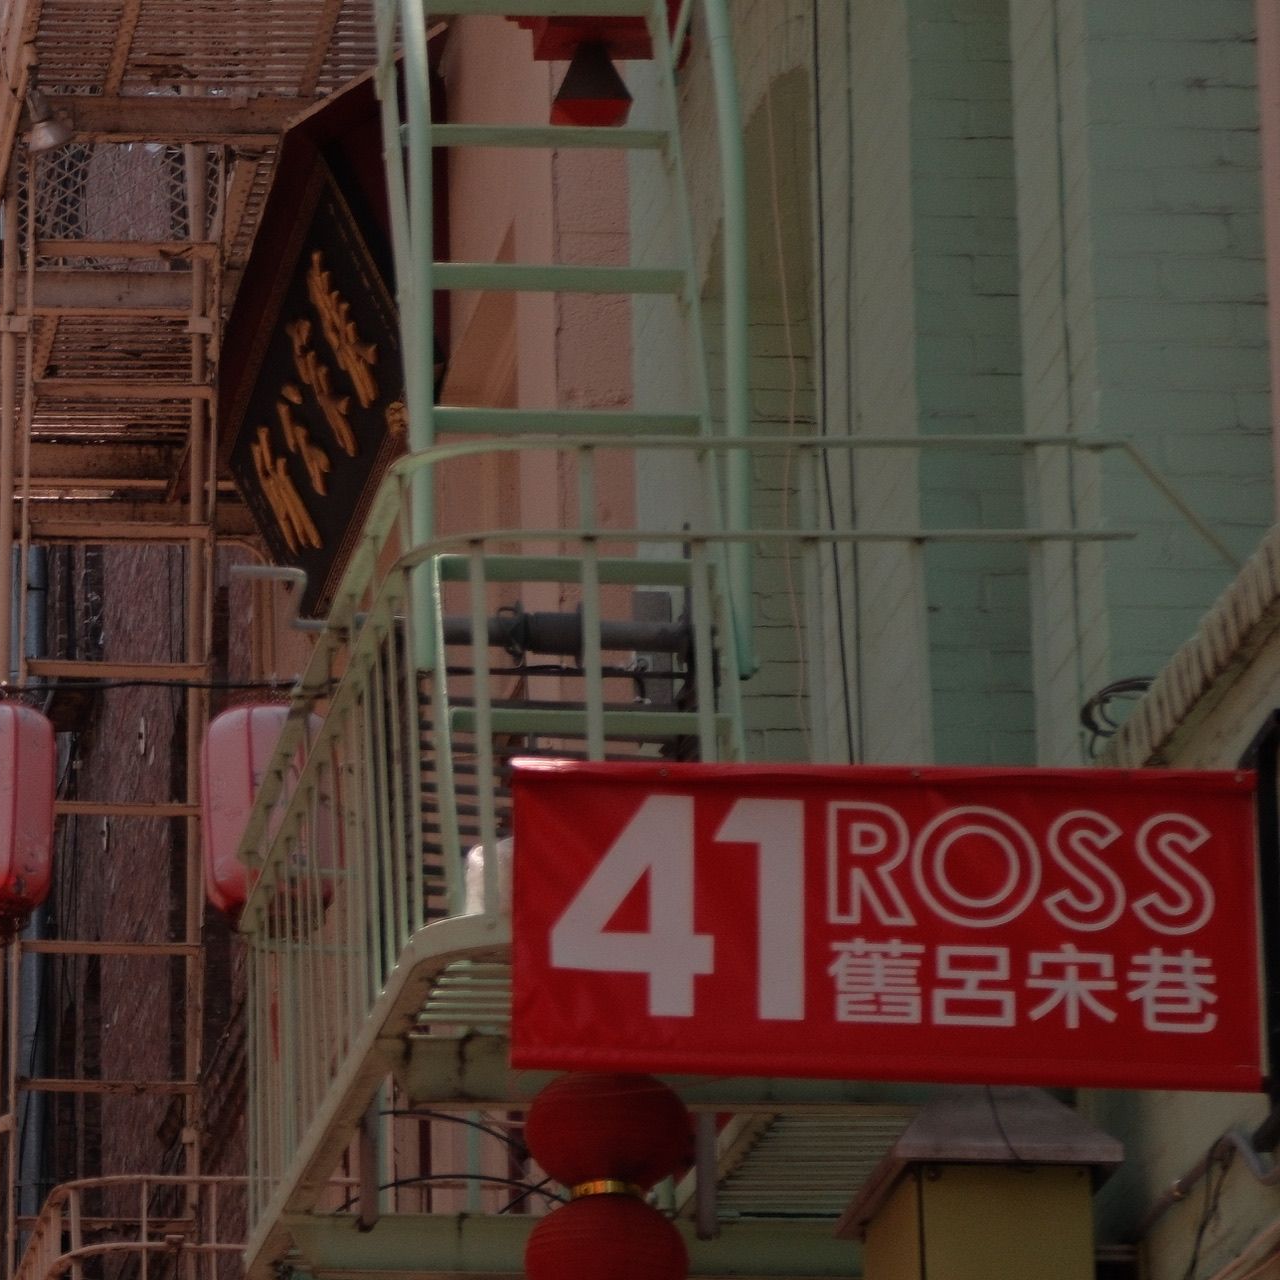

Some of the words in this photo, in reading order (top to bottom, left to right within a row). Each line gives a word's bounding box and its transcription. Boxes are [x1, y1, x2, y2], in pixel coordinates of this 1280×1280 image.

[550, 795, 805, 1021] 41
[826, 800, 1217, 936] ROSS
[827, 937, 1220, 1035] 舊呂宋巷
